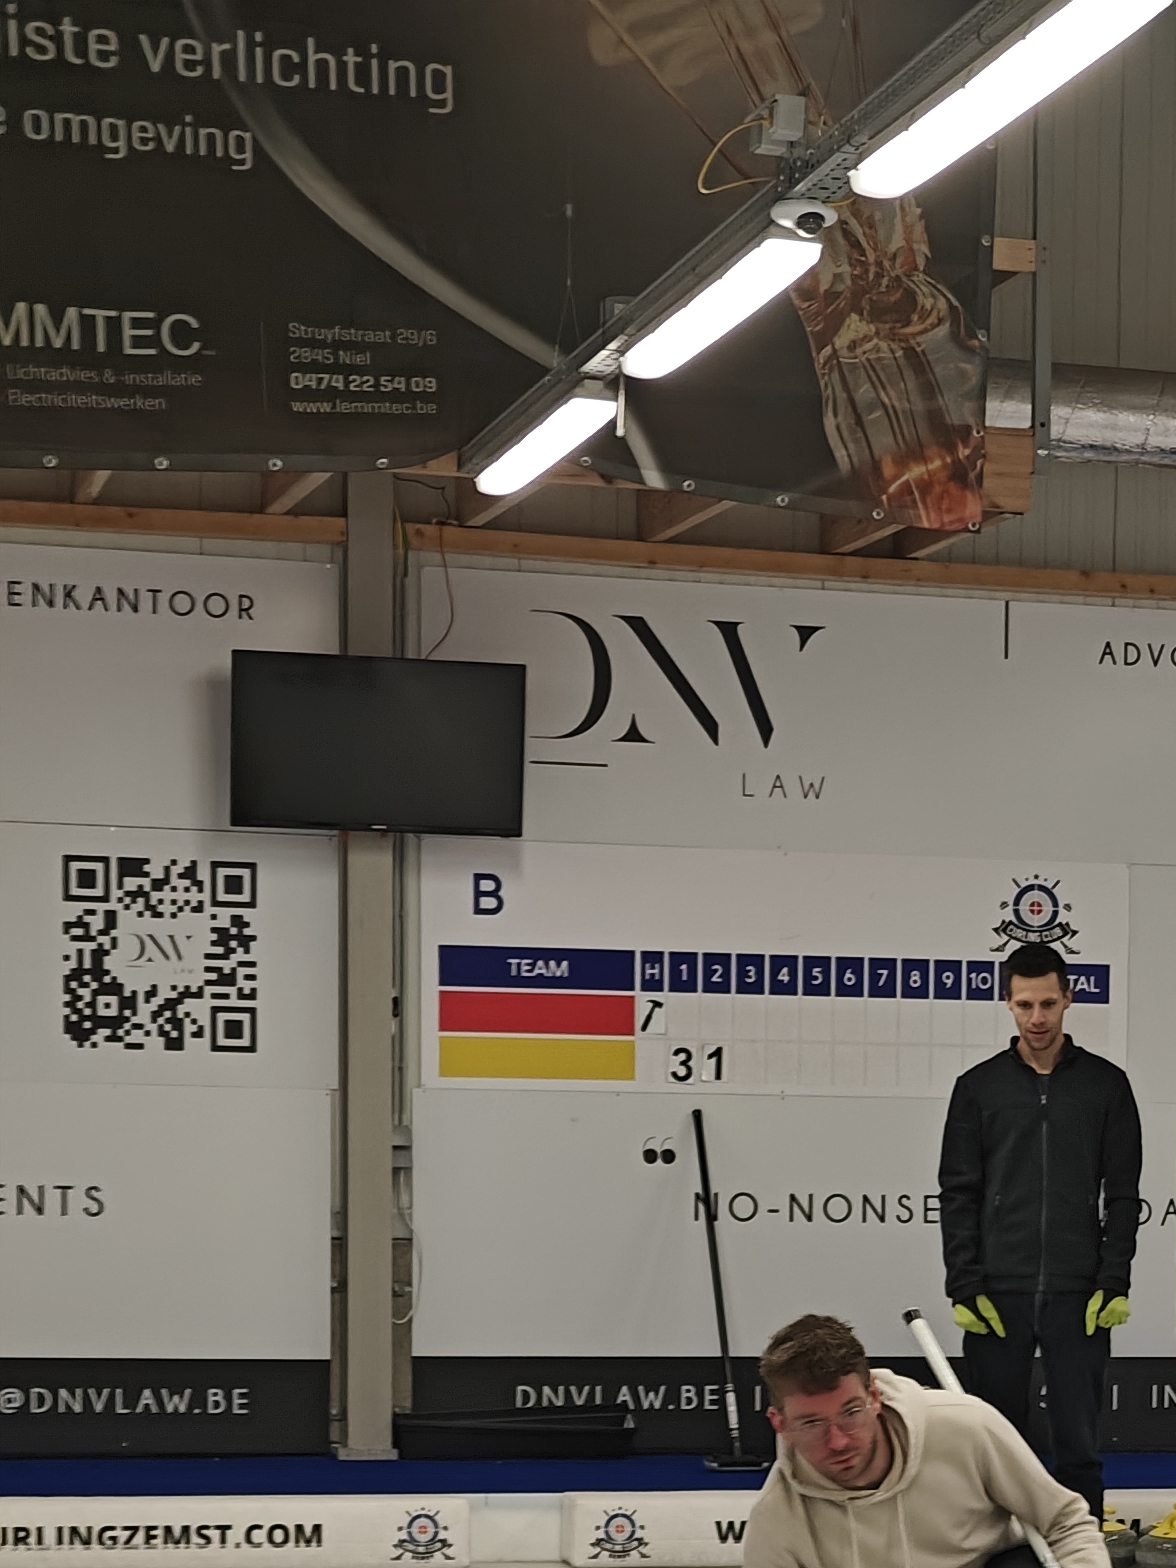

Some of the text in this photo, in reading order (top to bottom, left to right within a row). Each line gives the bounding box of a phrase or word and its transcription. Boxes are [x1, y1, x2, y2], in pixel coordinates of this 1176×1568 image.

[6, 4, 453, 113] iste verlichting
[23, 109, 253, 169] omgeving
[289, 322, 391, 343] Struyfstraat
[289, 347, 370, 365] 2845 Niel
[6, 364, 99, 382] Lichtadvies
[290, 373, 437, 392] 0474 22 54 09
[8, 389, 166, 410] Electriciteitswerken
[291, 399, 437, 414] www.lemmtec.be
[6, 580, 255, 621] ENKANTOOR
[742, 772, 825, 800] LAW
[473, 873, 504, 916] B
[506, 958, 1101, 993] TEAM H 1 2 3 4 5 6 7 8 9 10 TAL
[670, 1045, 724, 1082] 3 1
